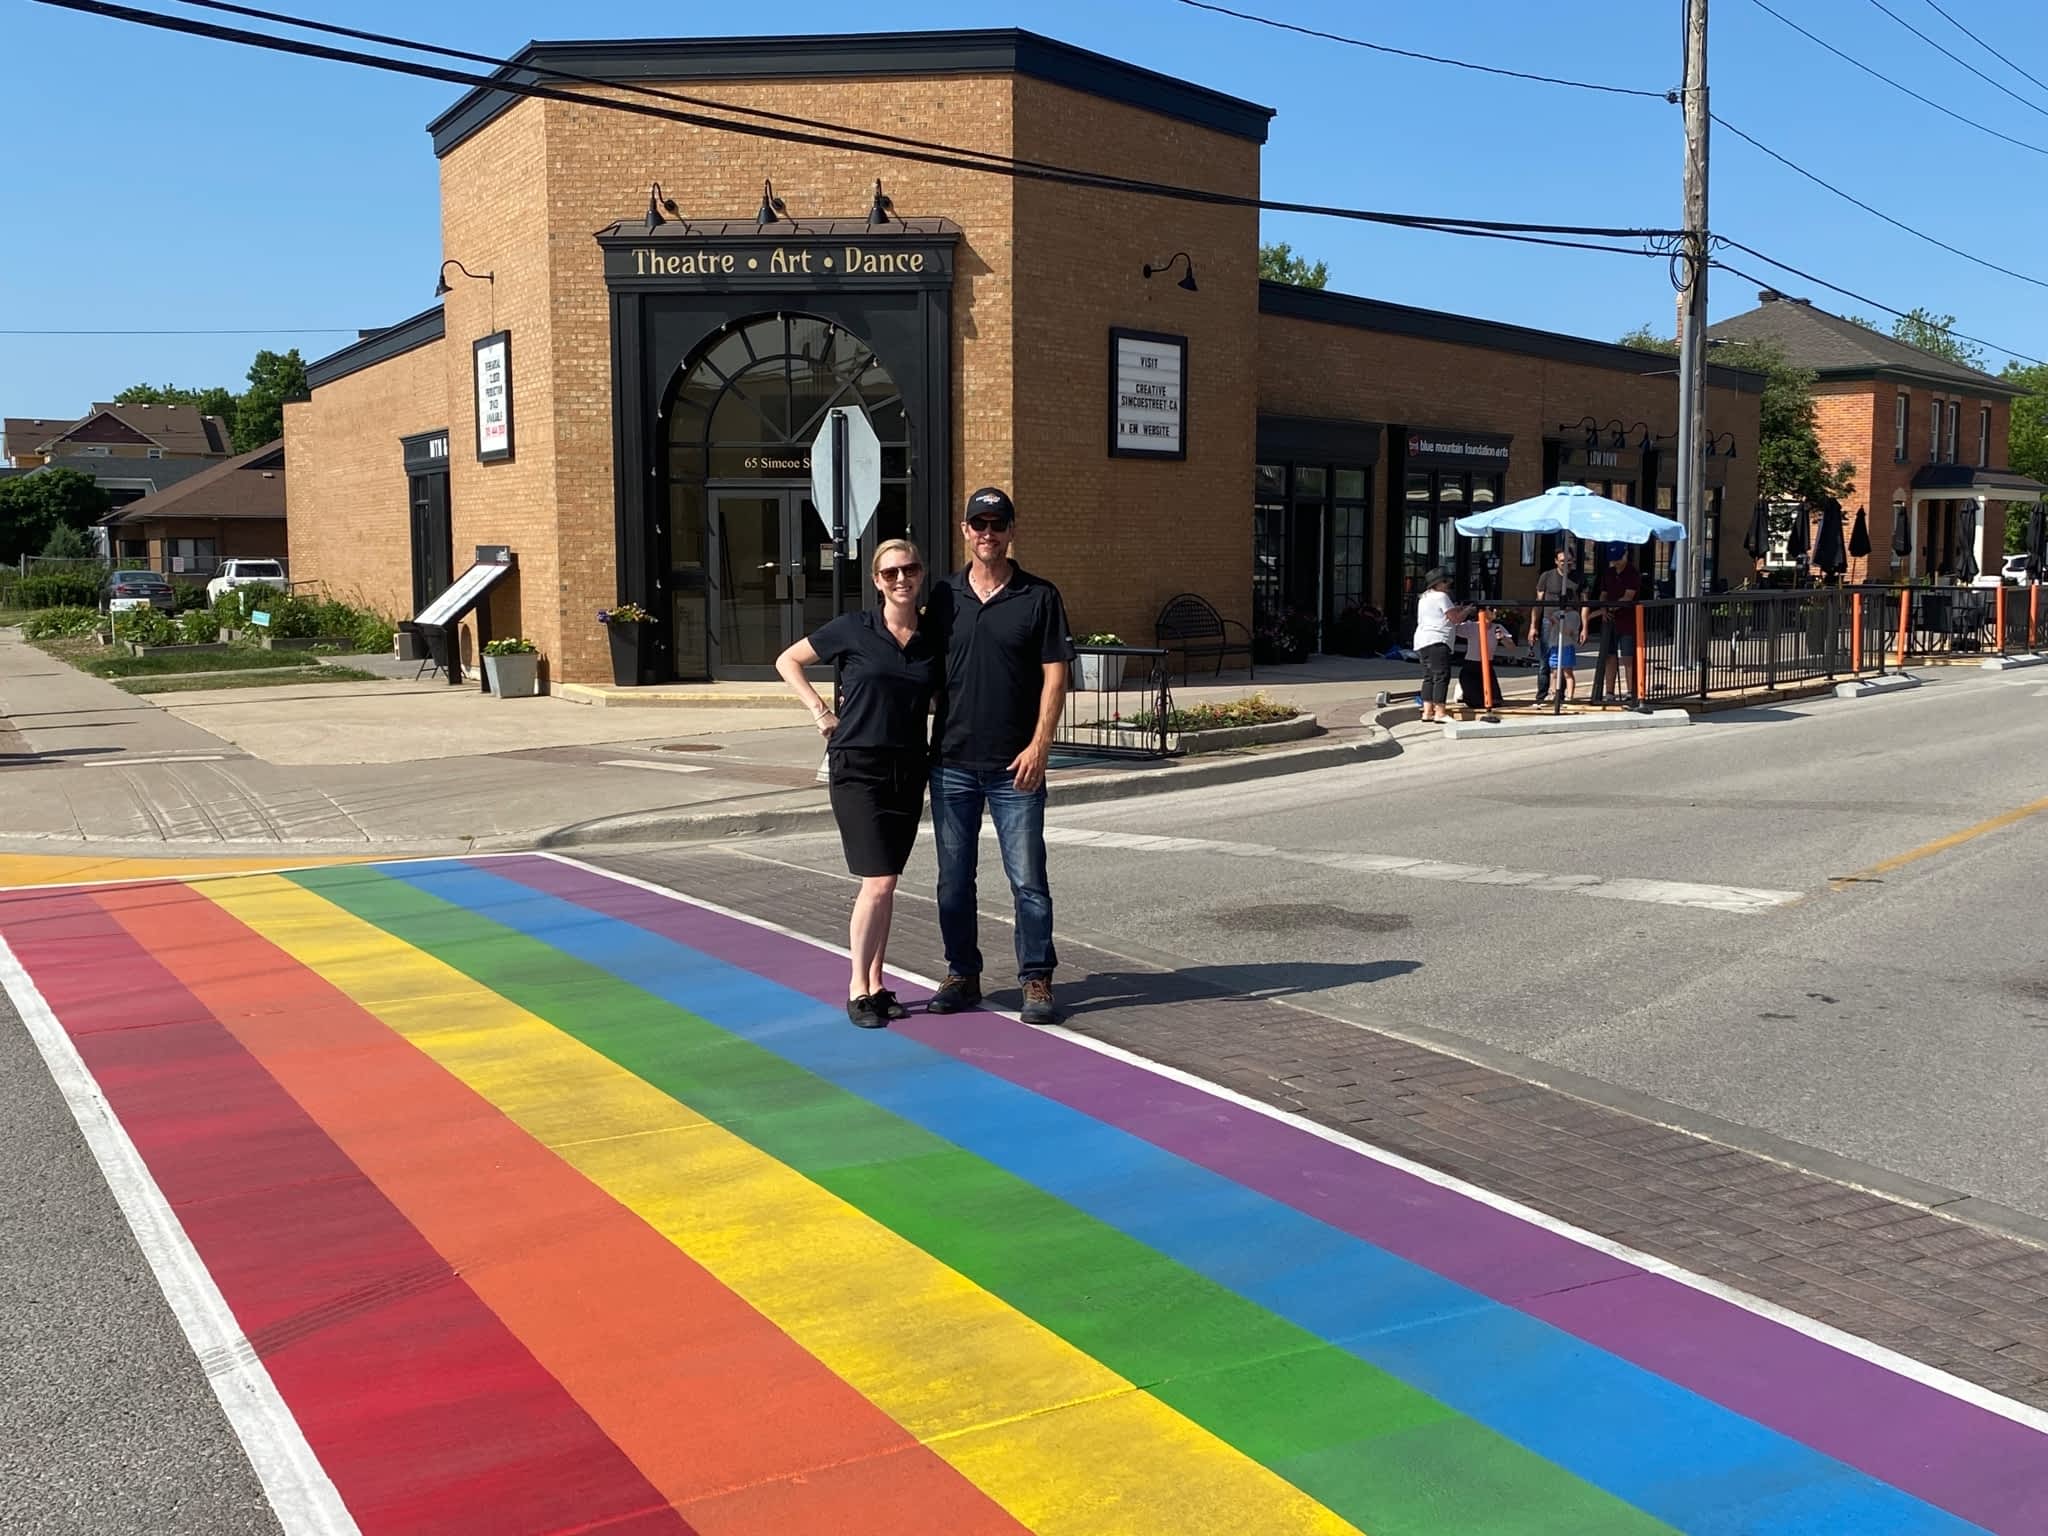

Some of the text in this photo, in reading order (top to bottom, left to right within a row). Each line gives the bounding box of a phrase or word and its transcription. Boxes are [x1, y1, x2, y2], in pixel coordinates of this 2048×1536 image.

[631, 247, 924, 275] Theatre Art Dance
[1140, 357, 1159, 369] VISIT
[1135, 383, 1167, 397] CREATIVE
[1143, 424, 1170, 437] WEBSITE
[1420, 440, 1434, 452] blue
[1435, 442, 1464, 454] mountain
[1465, 443, 1495, 457] foundation
[1495, 447, 1509, 458] arts
[744, 457, 758, 469] 65
[760, 457, 801, 469] Simcoe
